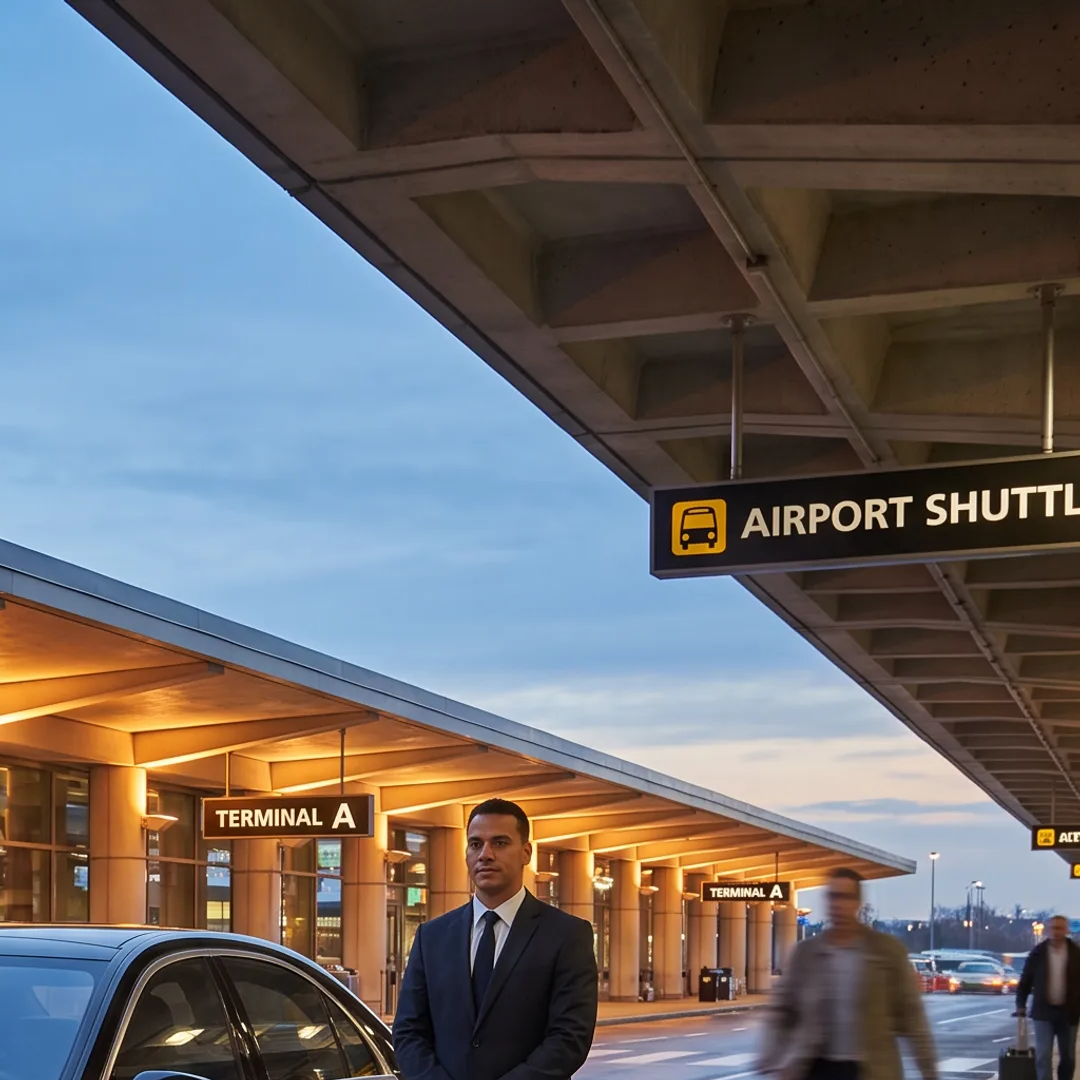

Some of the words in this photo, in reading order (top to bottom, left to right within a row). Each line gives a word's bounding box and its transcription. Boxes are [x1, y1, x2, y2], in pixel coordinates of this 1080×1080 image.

[740, 495, 914, 539] AIRPORT
[925, 483, 1080, 526] SHUTTL
[215, 807, 323, 828] TERMINAL
[331, 802, 357, 829] A
[709, 887, 766, 898] TERMINAL
[769, 884, 783, 899] A
